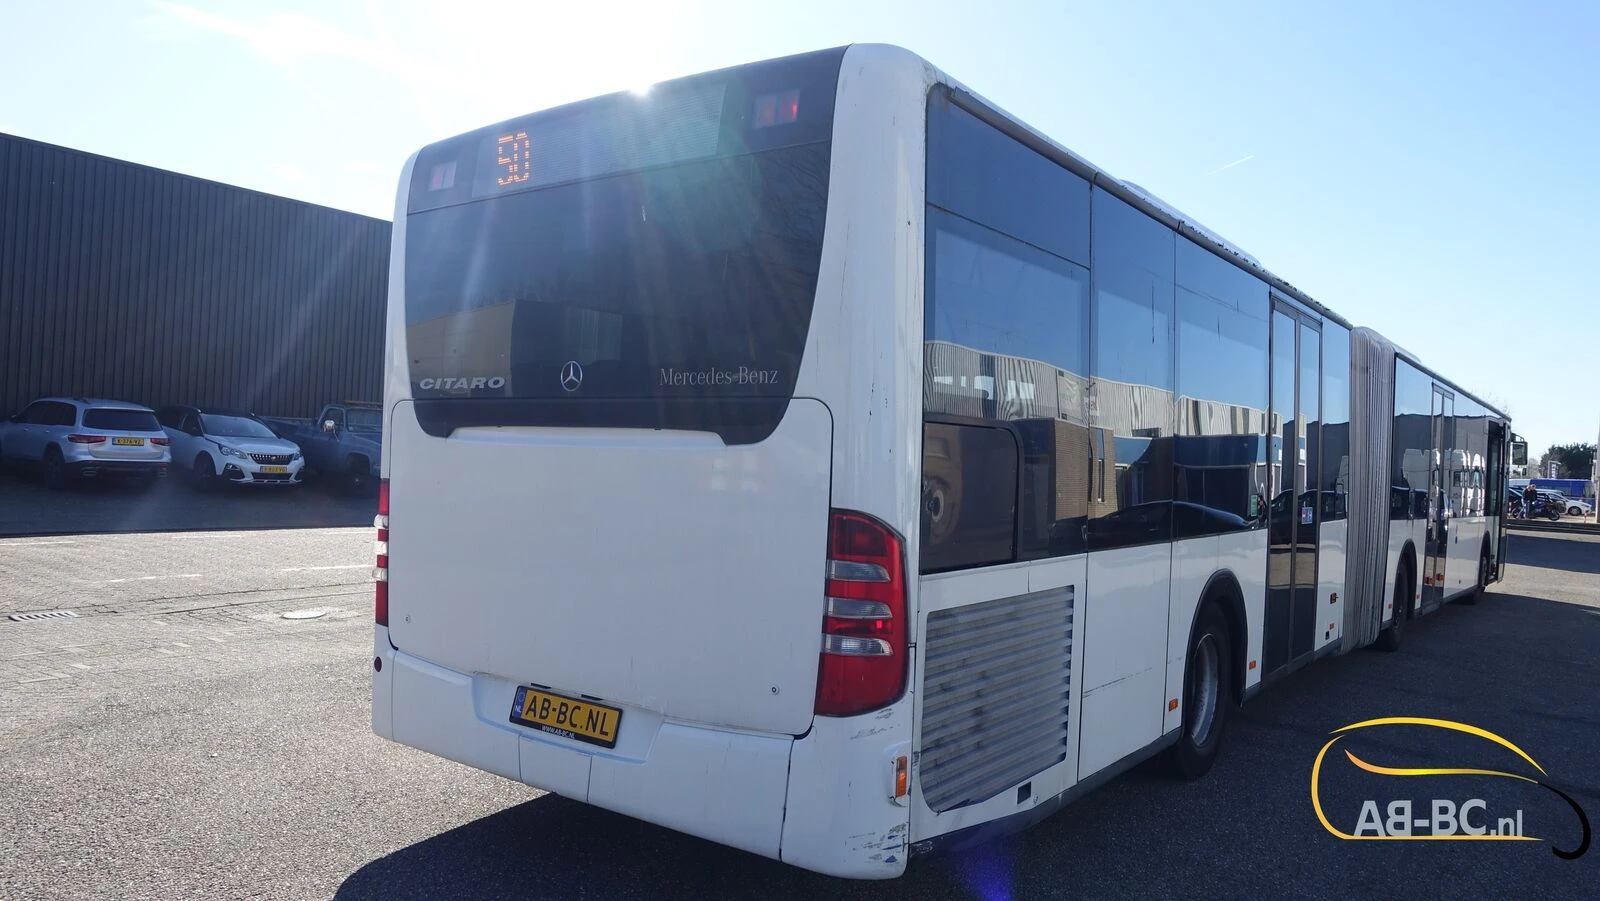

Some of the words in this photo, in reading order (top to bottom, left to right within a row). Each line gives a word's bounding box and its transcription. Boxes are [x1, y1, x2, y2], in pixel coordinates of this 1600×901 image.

[498, 131, 530, 185] 50
[419, 376, 505, 390] CITARO
[659, 366, 779, 386] Mercedes-Benz
[525, 695, 609, 736] AB-BC.NL
